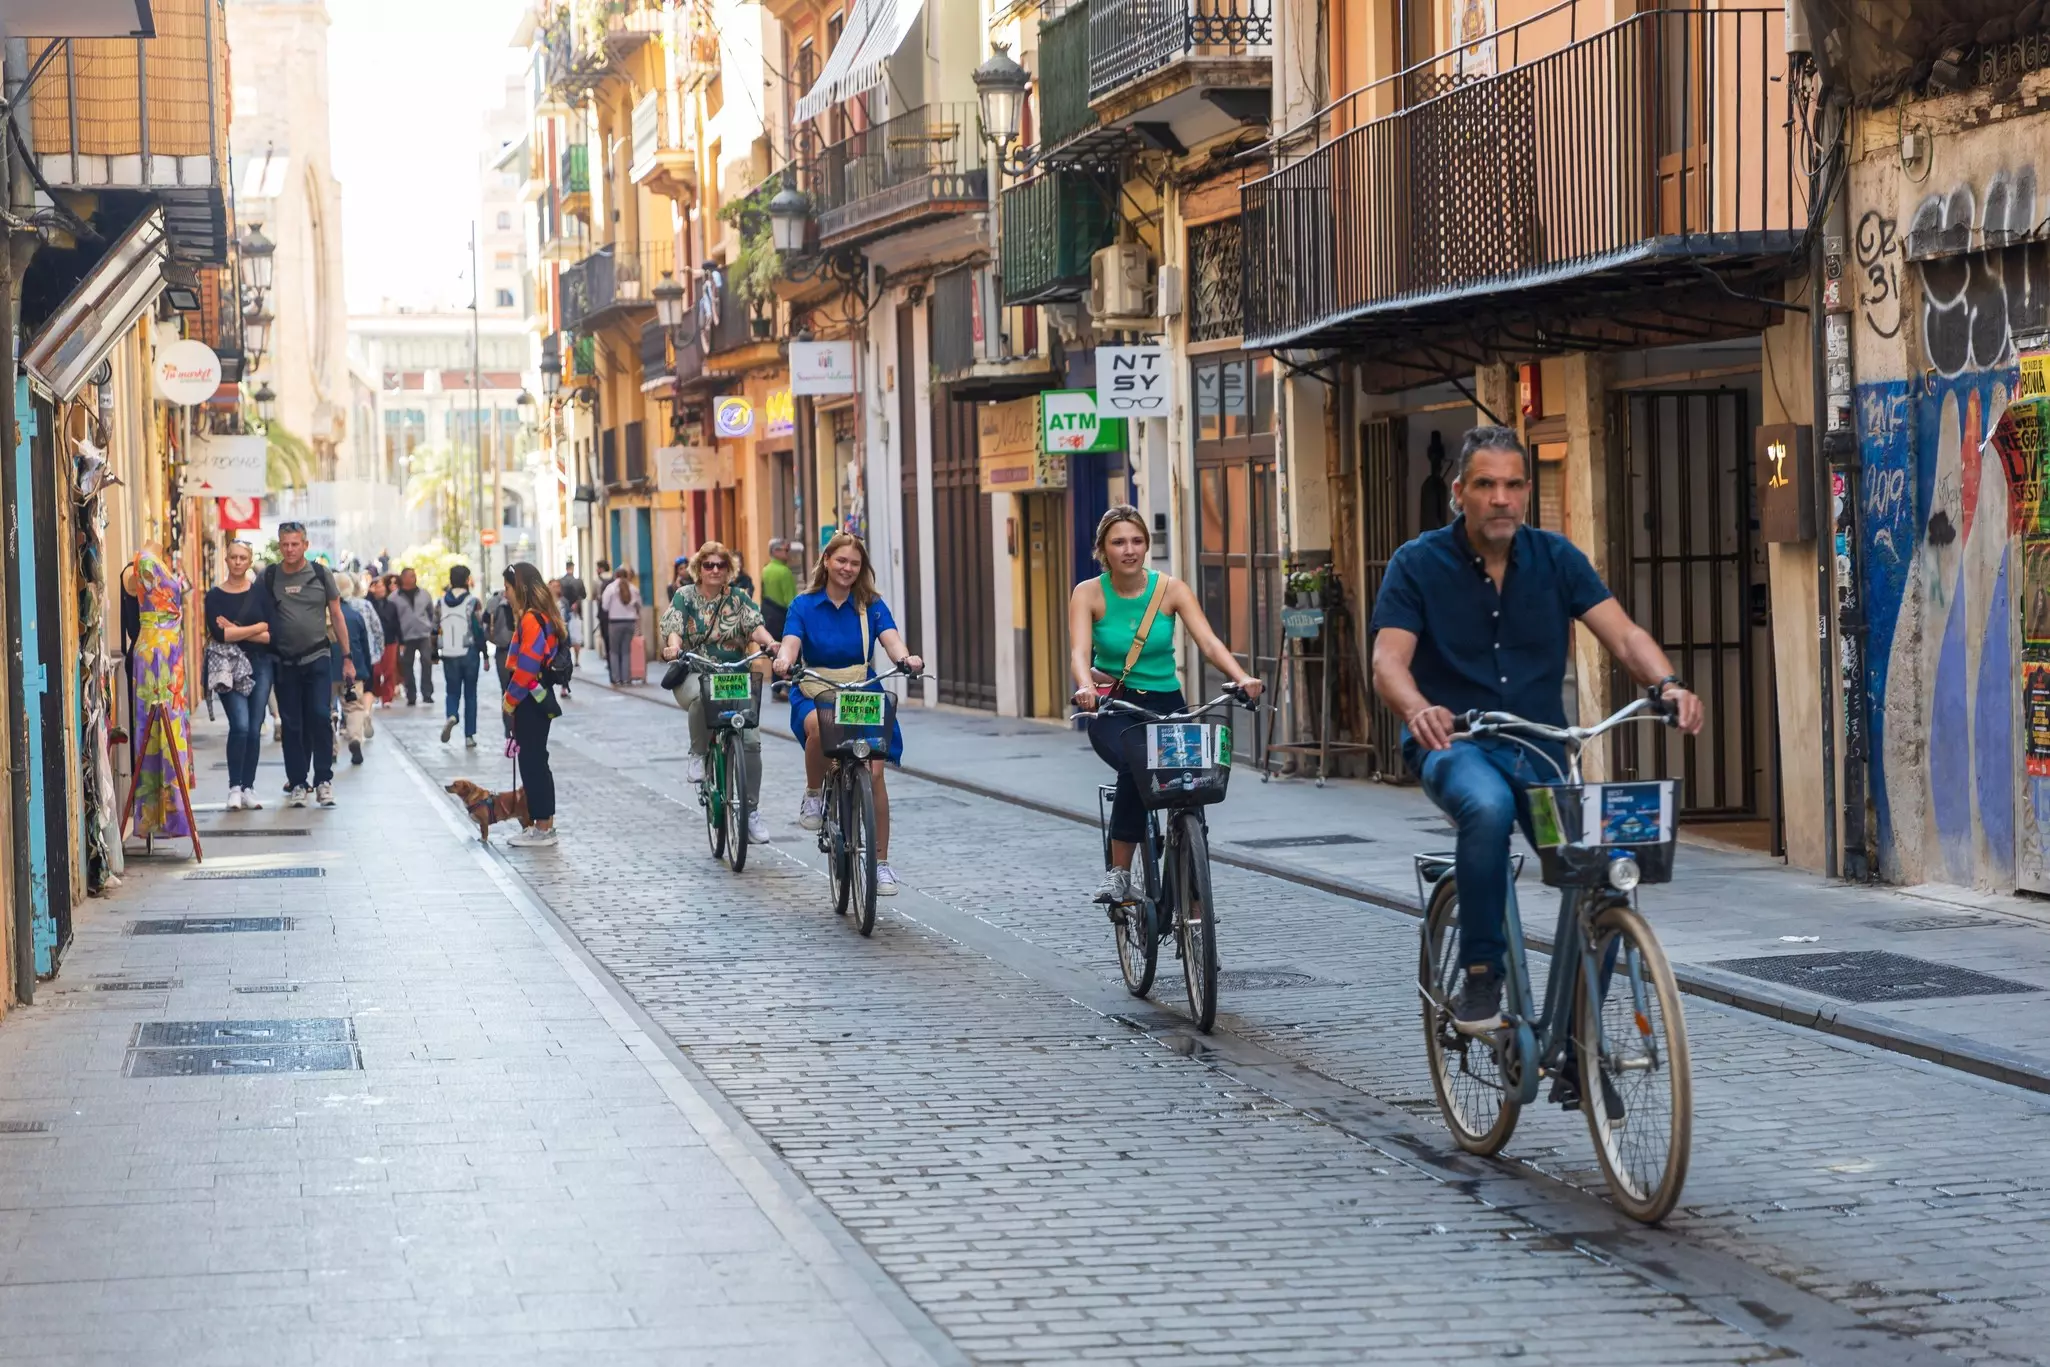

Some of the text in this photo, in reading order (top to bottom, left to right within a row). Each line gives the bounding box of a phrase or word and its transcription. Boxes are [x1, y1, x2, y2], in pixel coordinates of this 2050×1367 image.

[1113, 354, 1161, 370] NT
[1113, 374, 1160, 391] SY
[1049, 413, 1097, 431] ATM
[841, 705, 880, 714] BIKE RENT
